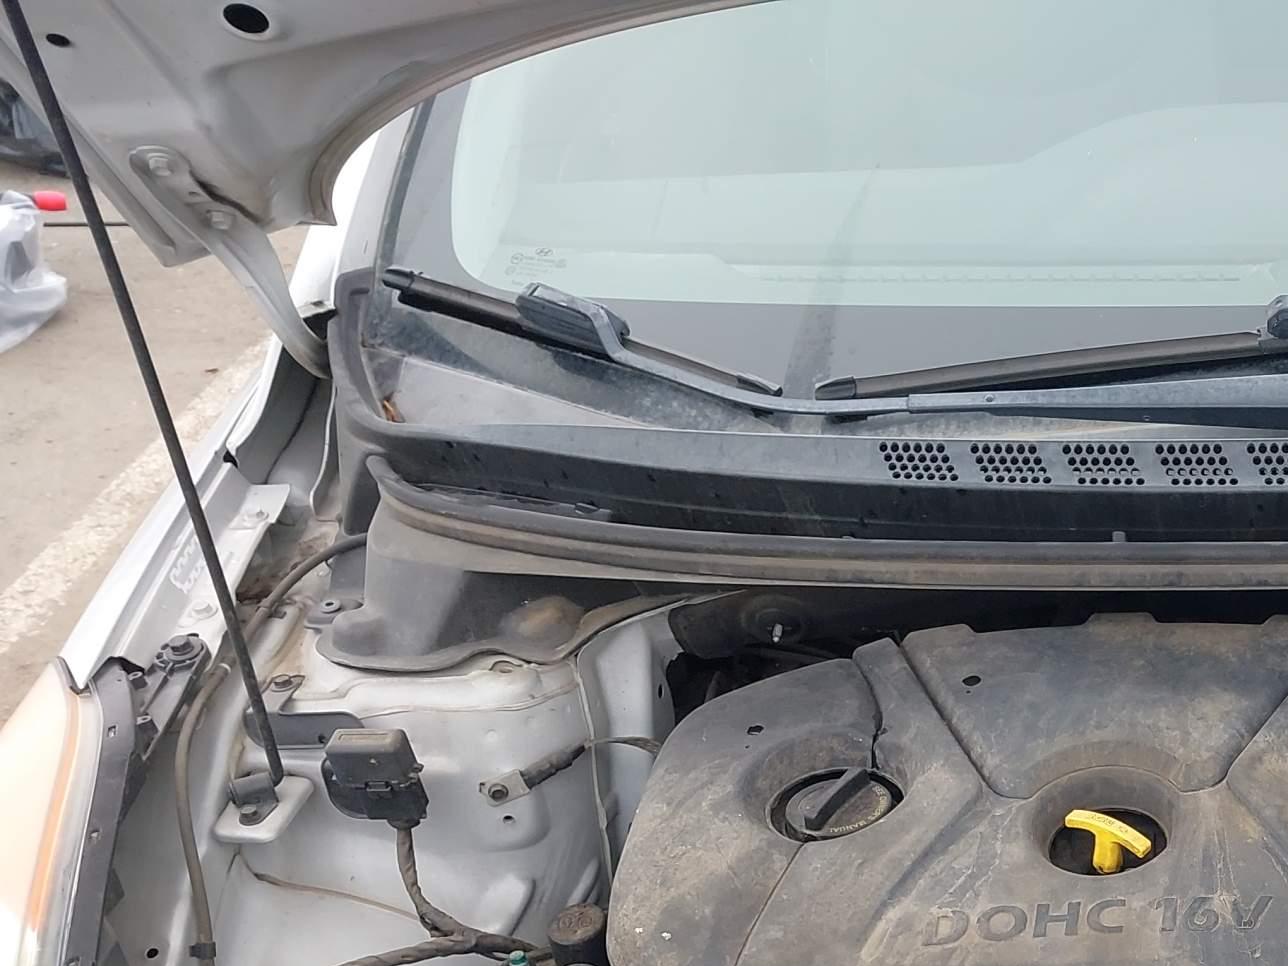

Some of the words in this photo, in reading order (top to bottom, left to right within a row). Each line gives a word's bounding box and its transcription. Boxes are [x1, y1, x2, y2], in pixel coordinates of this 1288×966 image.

[829, 820, 867, 833] MANUAL
[921, 897, 1127, 947] DOHC
[1153, 894, 1274, 933] 16V
